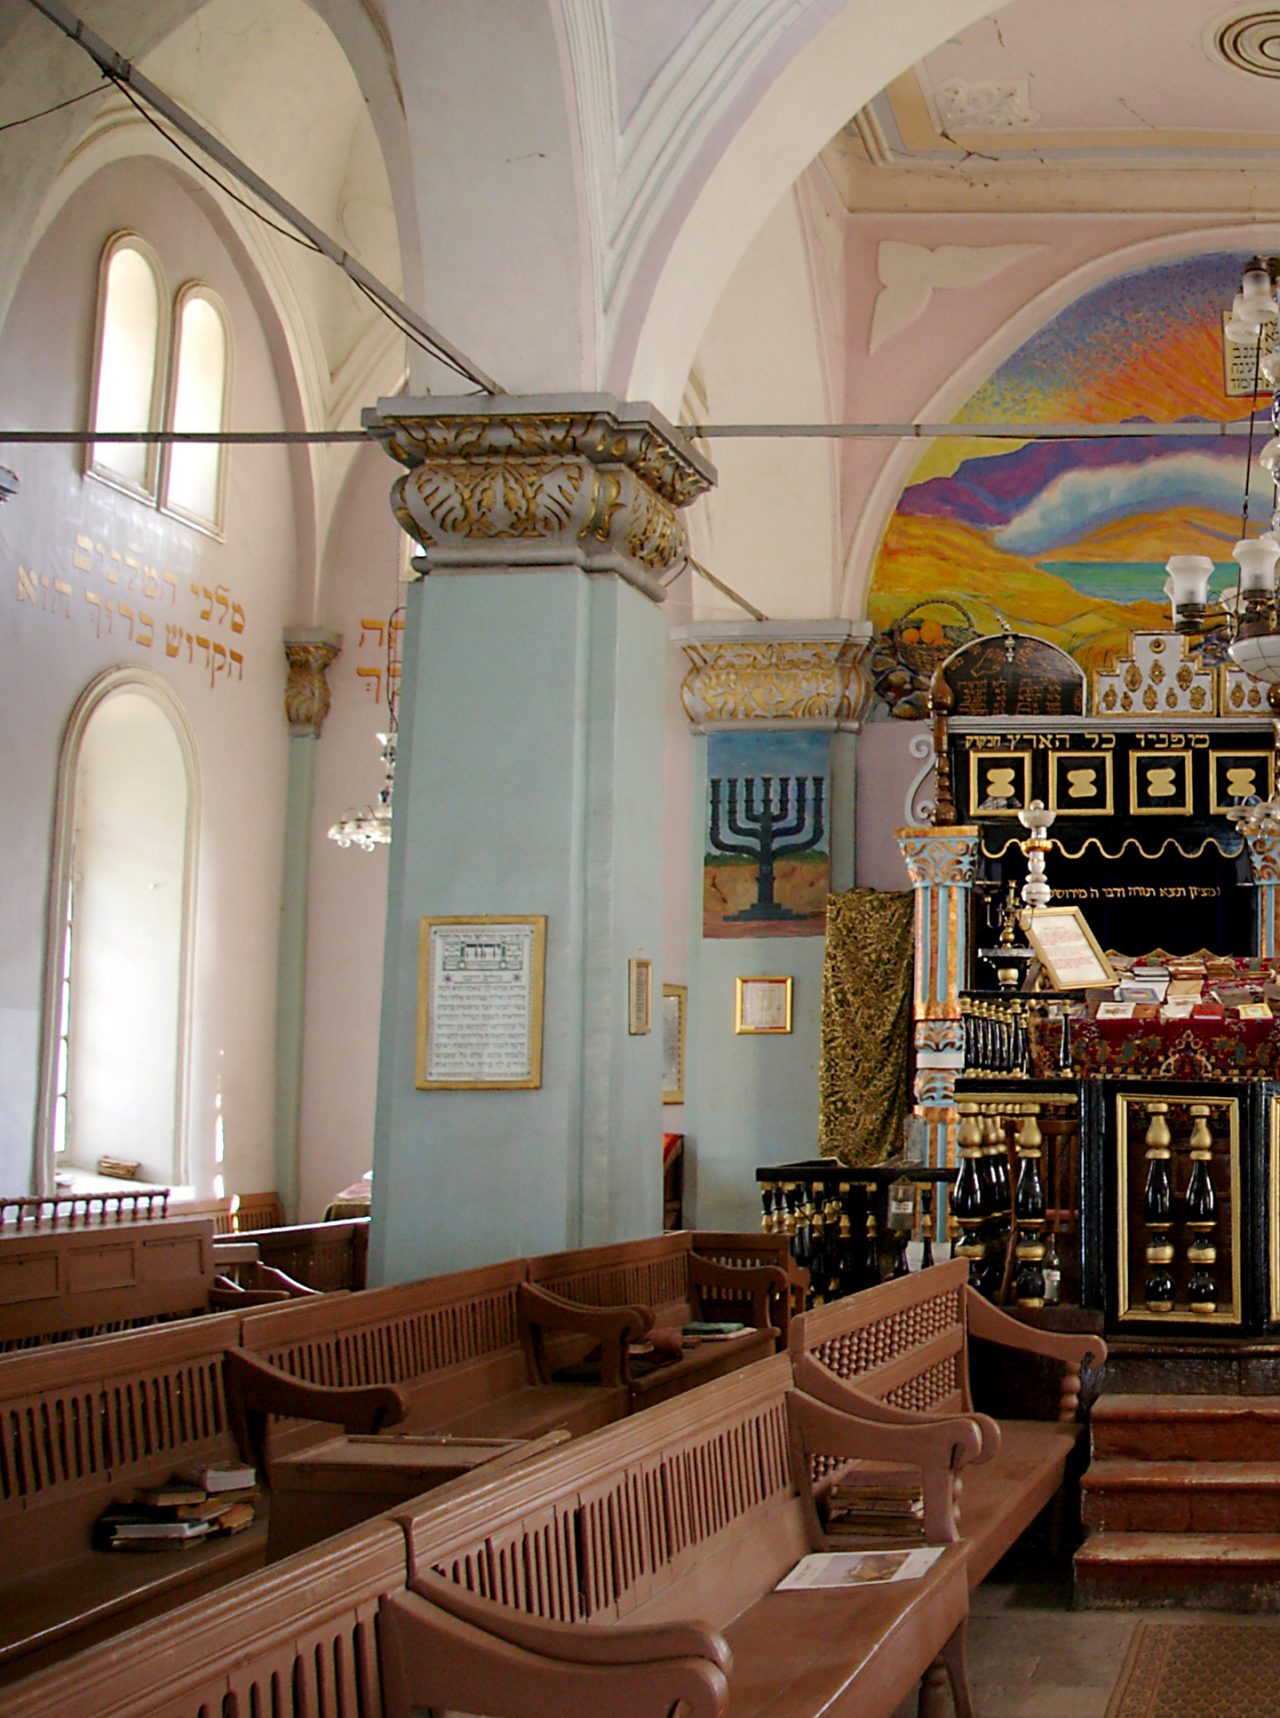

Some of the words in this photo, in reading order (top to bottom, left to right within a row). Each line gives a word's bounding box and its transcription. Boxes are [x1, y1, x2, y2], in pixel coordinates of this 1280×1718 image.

[16, 563, 72, 619] הוא
[73, 533, 178, 607] המלכים
[85, 589, 155, 648] ברוך
[190, 583, 246, 635] מלכי
[358, 619, 406, 648] תה
[165, 623, 244, 689] הקדוש
[1006, 733, 1070, 750] הארץ
[1084, 733, 1117, 749] כל
[1135, 733, 1210, 749] מפניו
